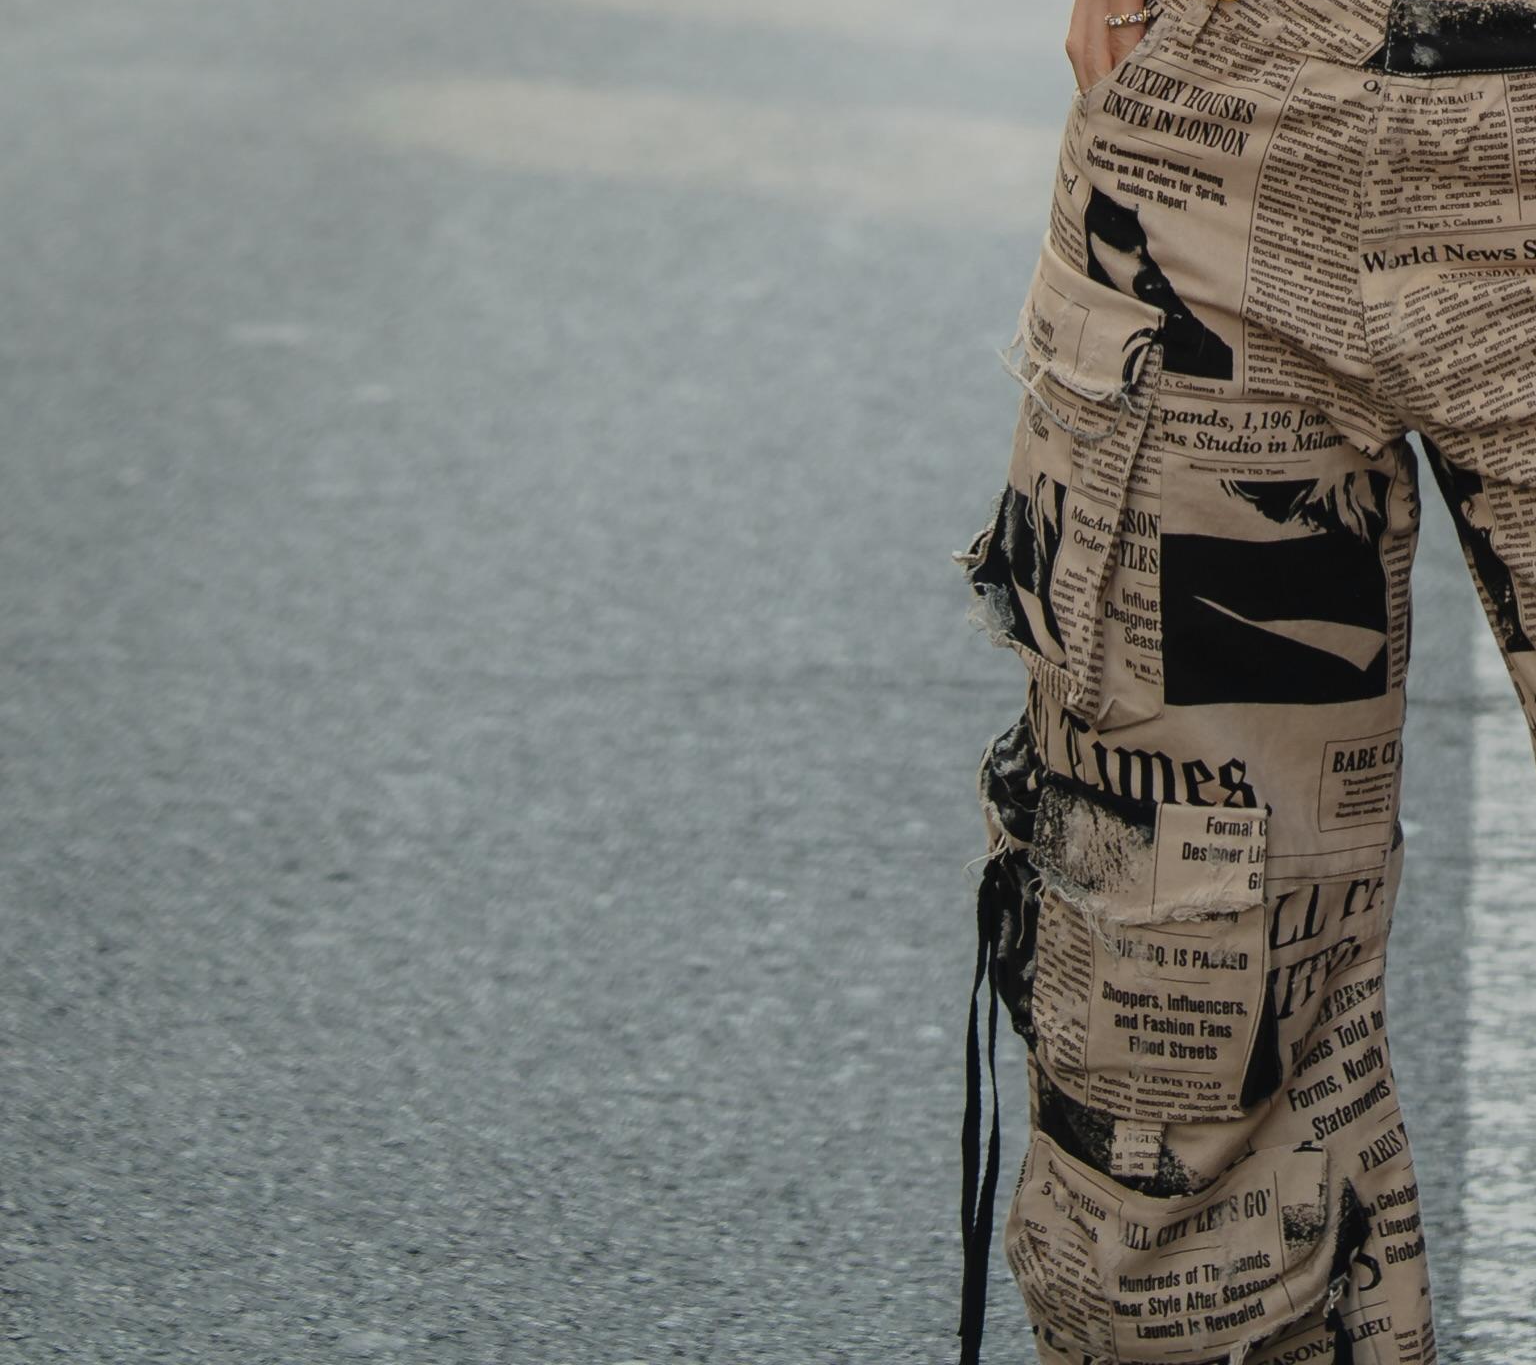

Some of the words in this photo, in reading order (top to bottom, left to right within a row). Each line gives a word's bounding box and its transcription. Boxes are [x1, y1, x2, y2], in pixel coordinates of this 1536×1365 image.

[1114, 62, 1183, 107] LUXURY
[1182, 86, 1257, 125] HOUSES
[1302, 87, 1337, 102] Fashion
[1102, 90, 1149, 128] UNITE
[1153, 110, 1177, 136] IN
[1175, 115, 1251, 157] LONDON
[1092, 135, 1107, 151] Full
[1109, 141, 1160, 167] Consensus
[1161, 155, 1190, 177] Found
[1191, 164, 1224, 189] Among
[1087, 149, 1116, 175] Stylists
[1117, 161, 1129, 175] on
[1131, 163, 1145, 182] All
[1146, 169, 1177, 193] Colors
[1178, 177, 1193, 195] for
[1195, 183, 1228, 207] Spring.
[1116, 178, 1156, 203] Insiders
[1156, 190, 1187, 212] Report
[1453, 217, 1494, 229] Column
[1255, 225, 1299, 246] emerging
[1300, 240, 1350, 261] aesthetics.
[1251, 257, 1294, 276] influence
[1252, 246, 1280, 261] Social
[1284, 257, 1312, 271] media
[1361, 245, 1438, 273] World
[1445, 244, 1517, 263] News
[1438, 269, 1521, 281] WEDNESDAY,
[1255, 287, 1290, 307] Fashion
[1175, 380, 1216, 396] Column
[1241, 410, 1293, 434] 1,196
[1193, 431, 1263, 455] Studio
[1267, 437, 1288, 454] in
[1291, 431, 1345, 454] Milan
[1332, 746, 1378, 774] BABE
[1173, 948, 1187, 967] IS
[1101, 981, 1164, 1012] Shoppers,
[1166, 993, 1248, 1018] Influencers,
[1114, 1013, 1139, 1031] and
[1142, 1014, 1195, 1038] Fashion
[1199, 1021, 1233, 1039] Fans
[1333, 1014, 1370, 1049] Told
[1370, 1008, 1384, 1029] to
[1169, 1040, 1219, 1061] Streets
[1142, 1072, 1184, 1088] LEWIS
[1185, 1080, 1223, 1091] TOAD
[1287, 1073, 1343, 1113] Forms,
[1341, 1044, 1384, 1085] Notify
[1311, 1078, 1391, 1142] Statements
[1357, 1131, 1403, 1173] PARIS
[1041, 1181, 1052, 1196] 5
[1080, 1195, 1108, 1222] Hits
[1156, 1216, 1190, 1248] CITY
[1118, 1272, 1181, 1294] Hundreds
[1185, 1271, 1200, 1286] of
[1149, 1296, 1183, 1318] Style
[1185, 1291, 1218, 1311] After
[1136, 1321, 1185, 1340] Launch
[1189, 1317, 1201, 1335] Is
[1205, 1299, 1266, 1334] Revealed
